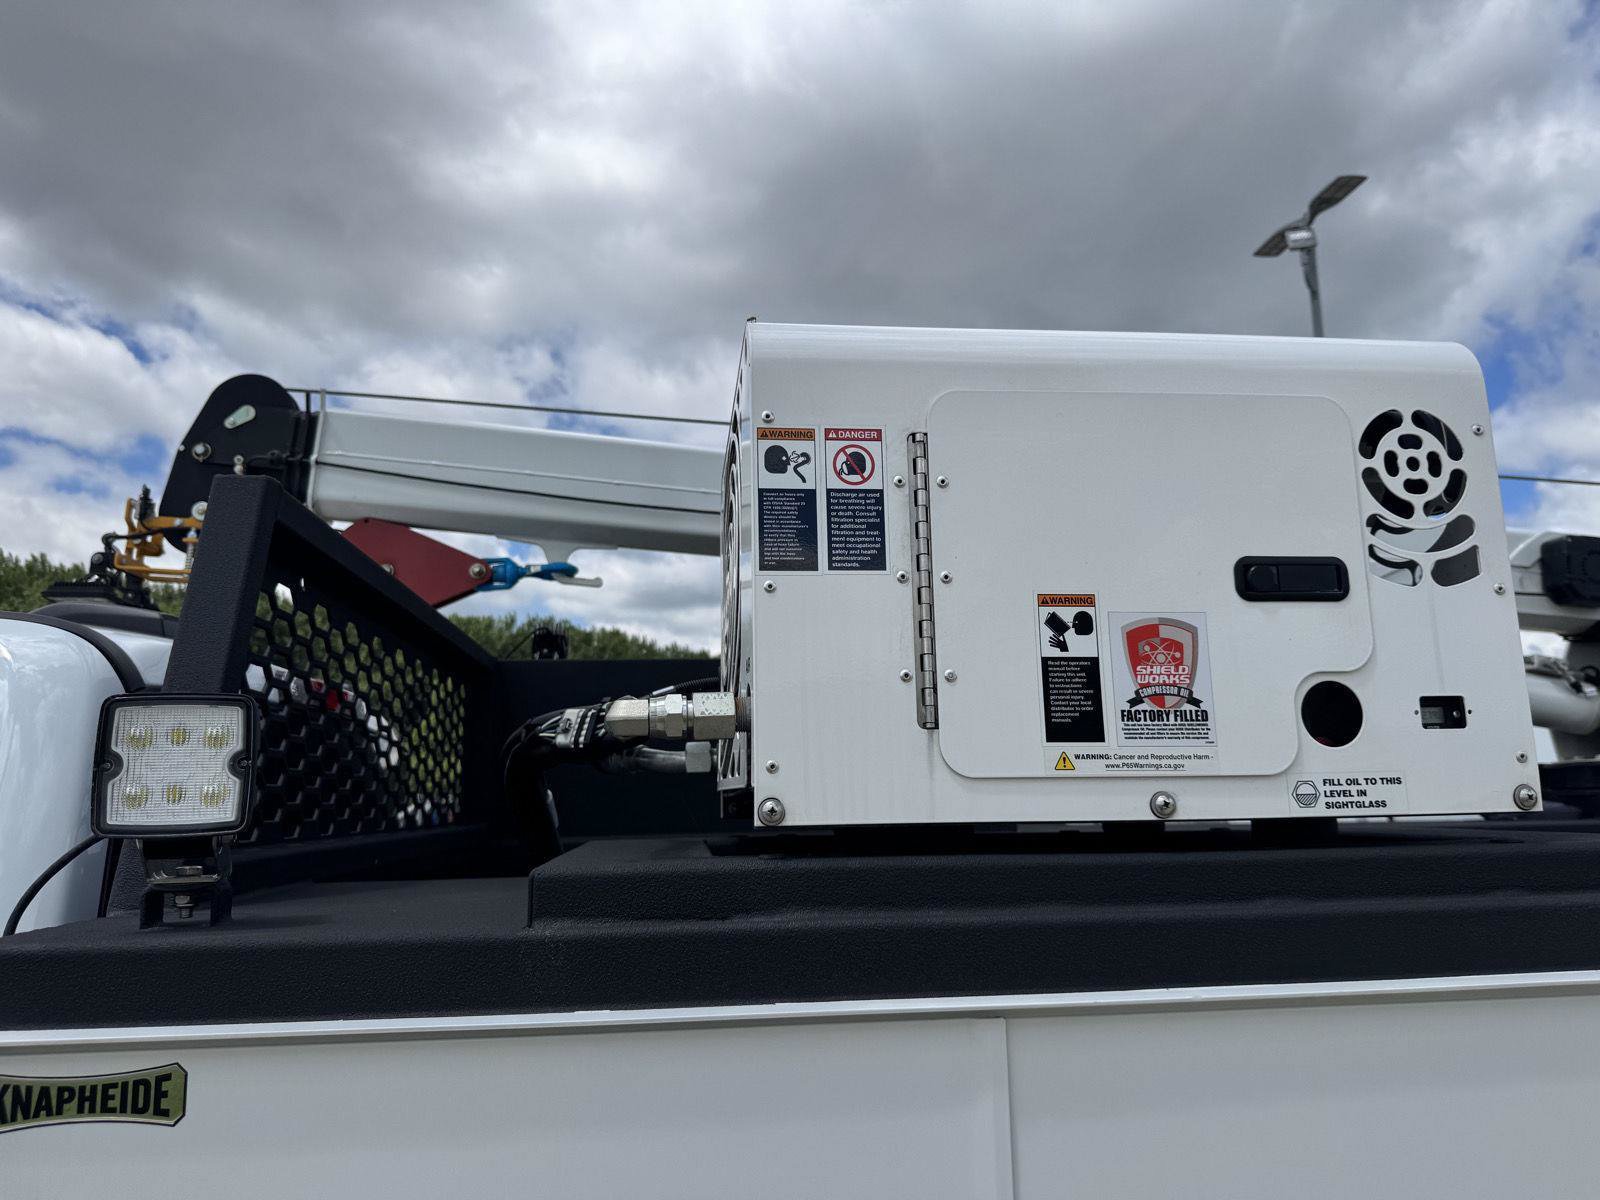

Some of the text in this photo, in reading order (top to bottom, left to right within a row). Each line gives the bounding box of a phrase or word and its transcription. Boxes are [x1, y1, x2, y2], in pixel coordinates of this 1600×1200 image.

[1050, 596, 1093, 604] WARNING
[1136, 666, 1188, 674] SHIELD
[1136, 675, 1190, 683] WORKS
[1139, 686, 1189, 697] COMPRESSOR OIL
[1121, 710, 1208, 722] FACTORY FILLED
[1151, 753, 1192, 761] Reproductive
[1323, 779, 1343, 787] FILL
[1346, 778, 1362, 786] OIL
[1379, 777, 1402, 785] THIS
[1324, 789, 1367, 798] LEVEL IN
[1325, 800, 1387, 809] SIGHTGLASS
